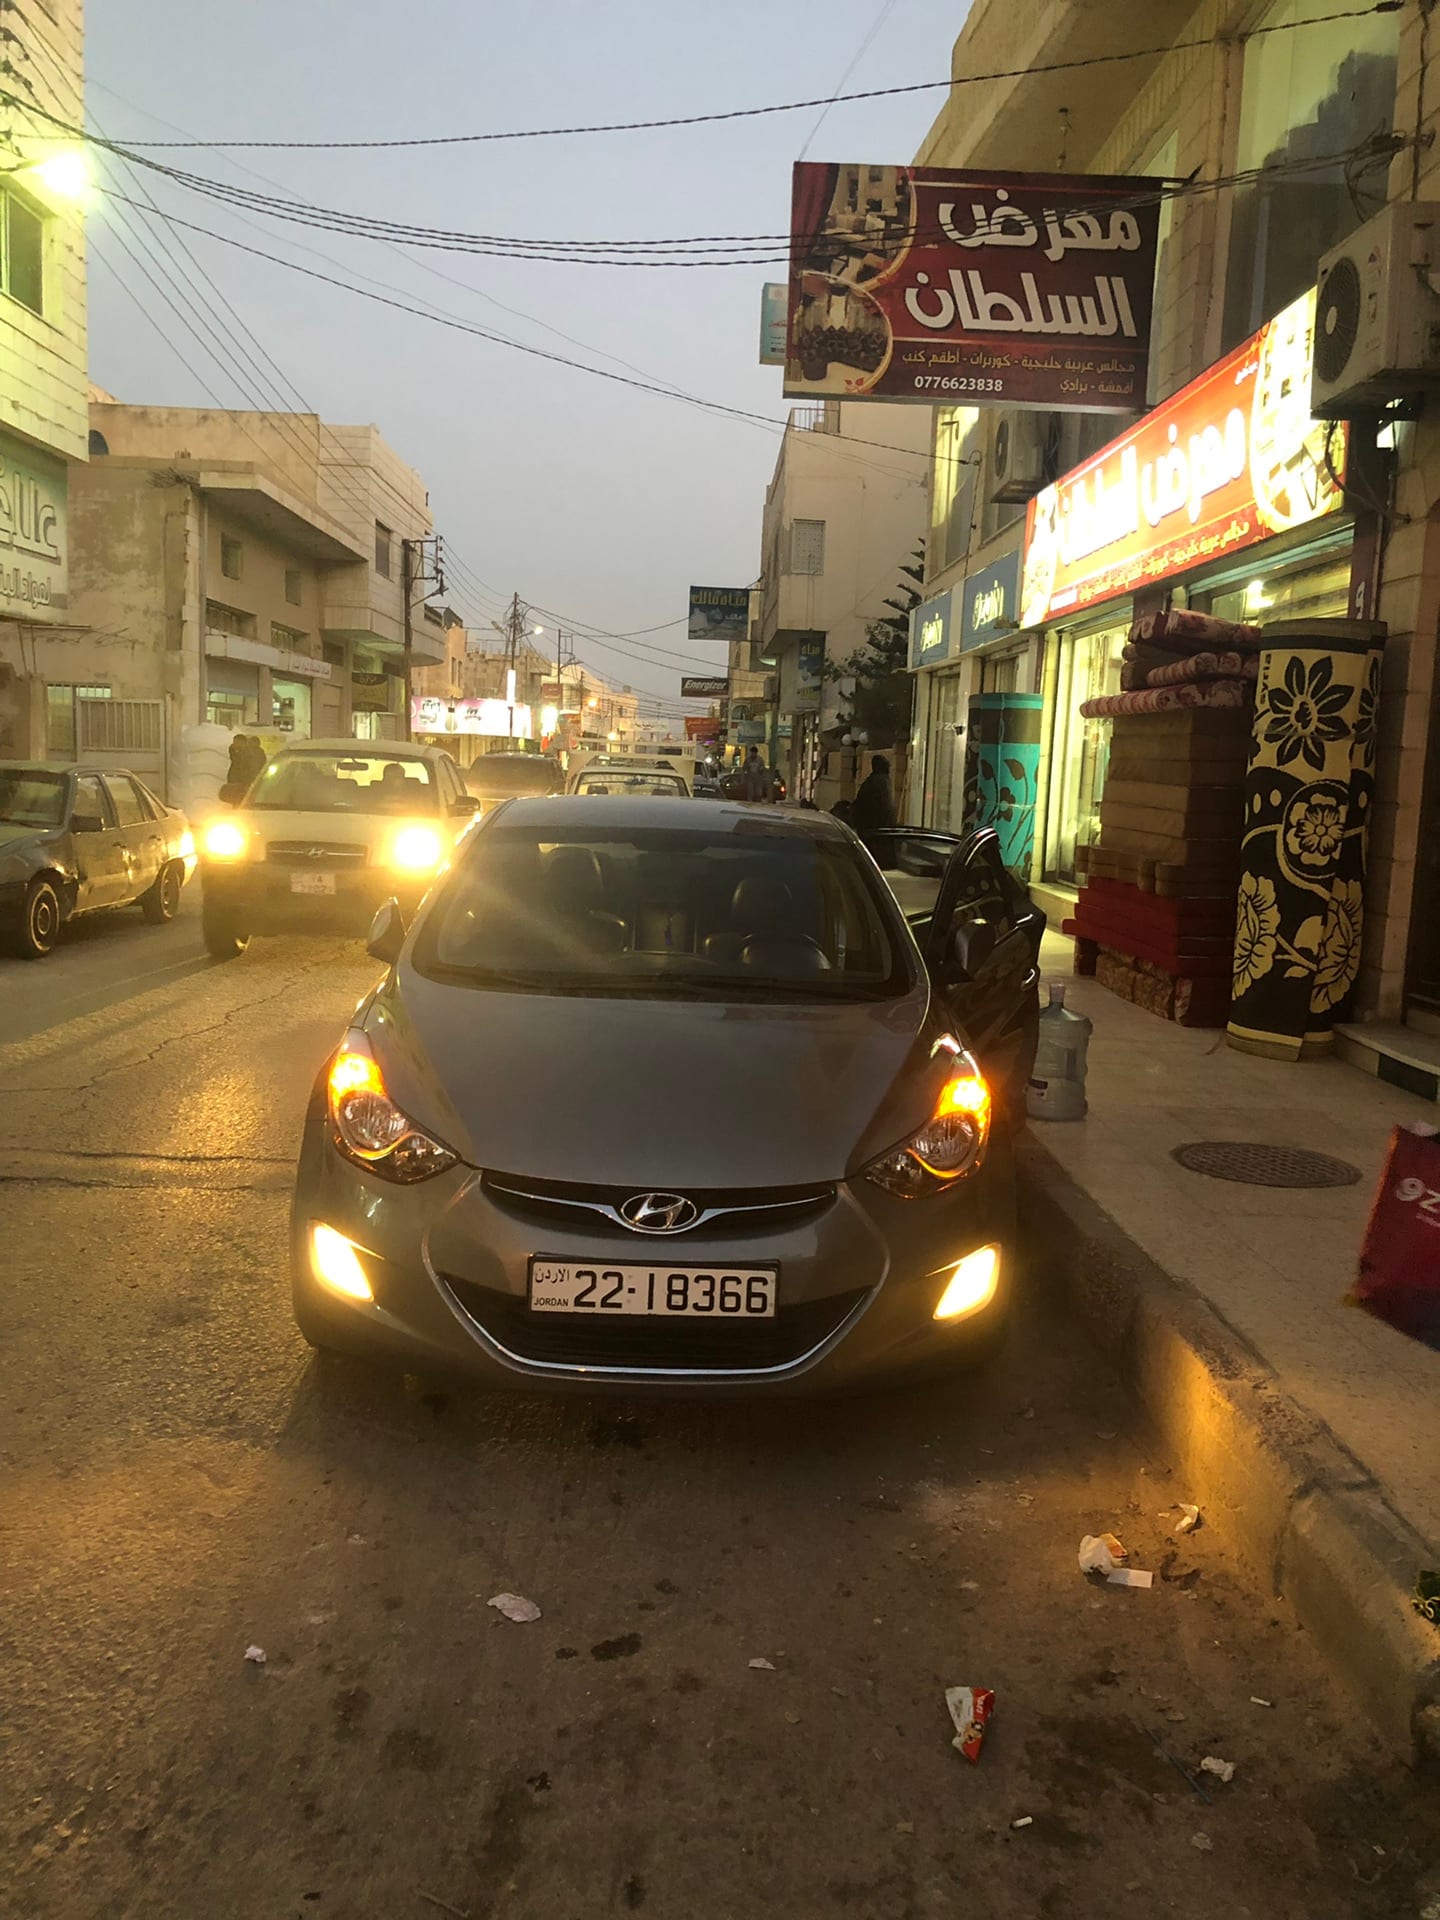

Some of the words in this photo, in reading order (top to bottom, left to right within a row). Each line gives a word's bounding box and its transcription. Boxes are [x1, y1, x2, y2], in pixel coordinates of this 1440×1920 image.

[938, 188, 1142, 263] معرض
[904, 268, 1138, 338] السلطان
[902, 350, 926, 365] كنب
[928, 347, 960, 368] أطقم
[1064, 357, 1094, 374] عربية
[1096, 359, 1136, 375] مجالس
[914, 375, 1004, 394] 0776623838
[1059, 377, 1088, 395] برادي
[683, 679, 727, 692] Energizer
[573, 1269, 769, 1315] 22-18366
[533, 1297, 569, 1308] JORDAN
